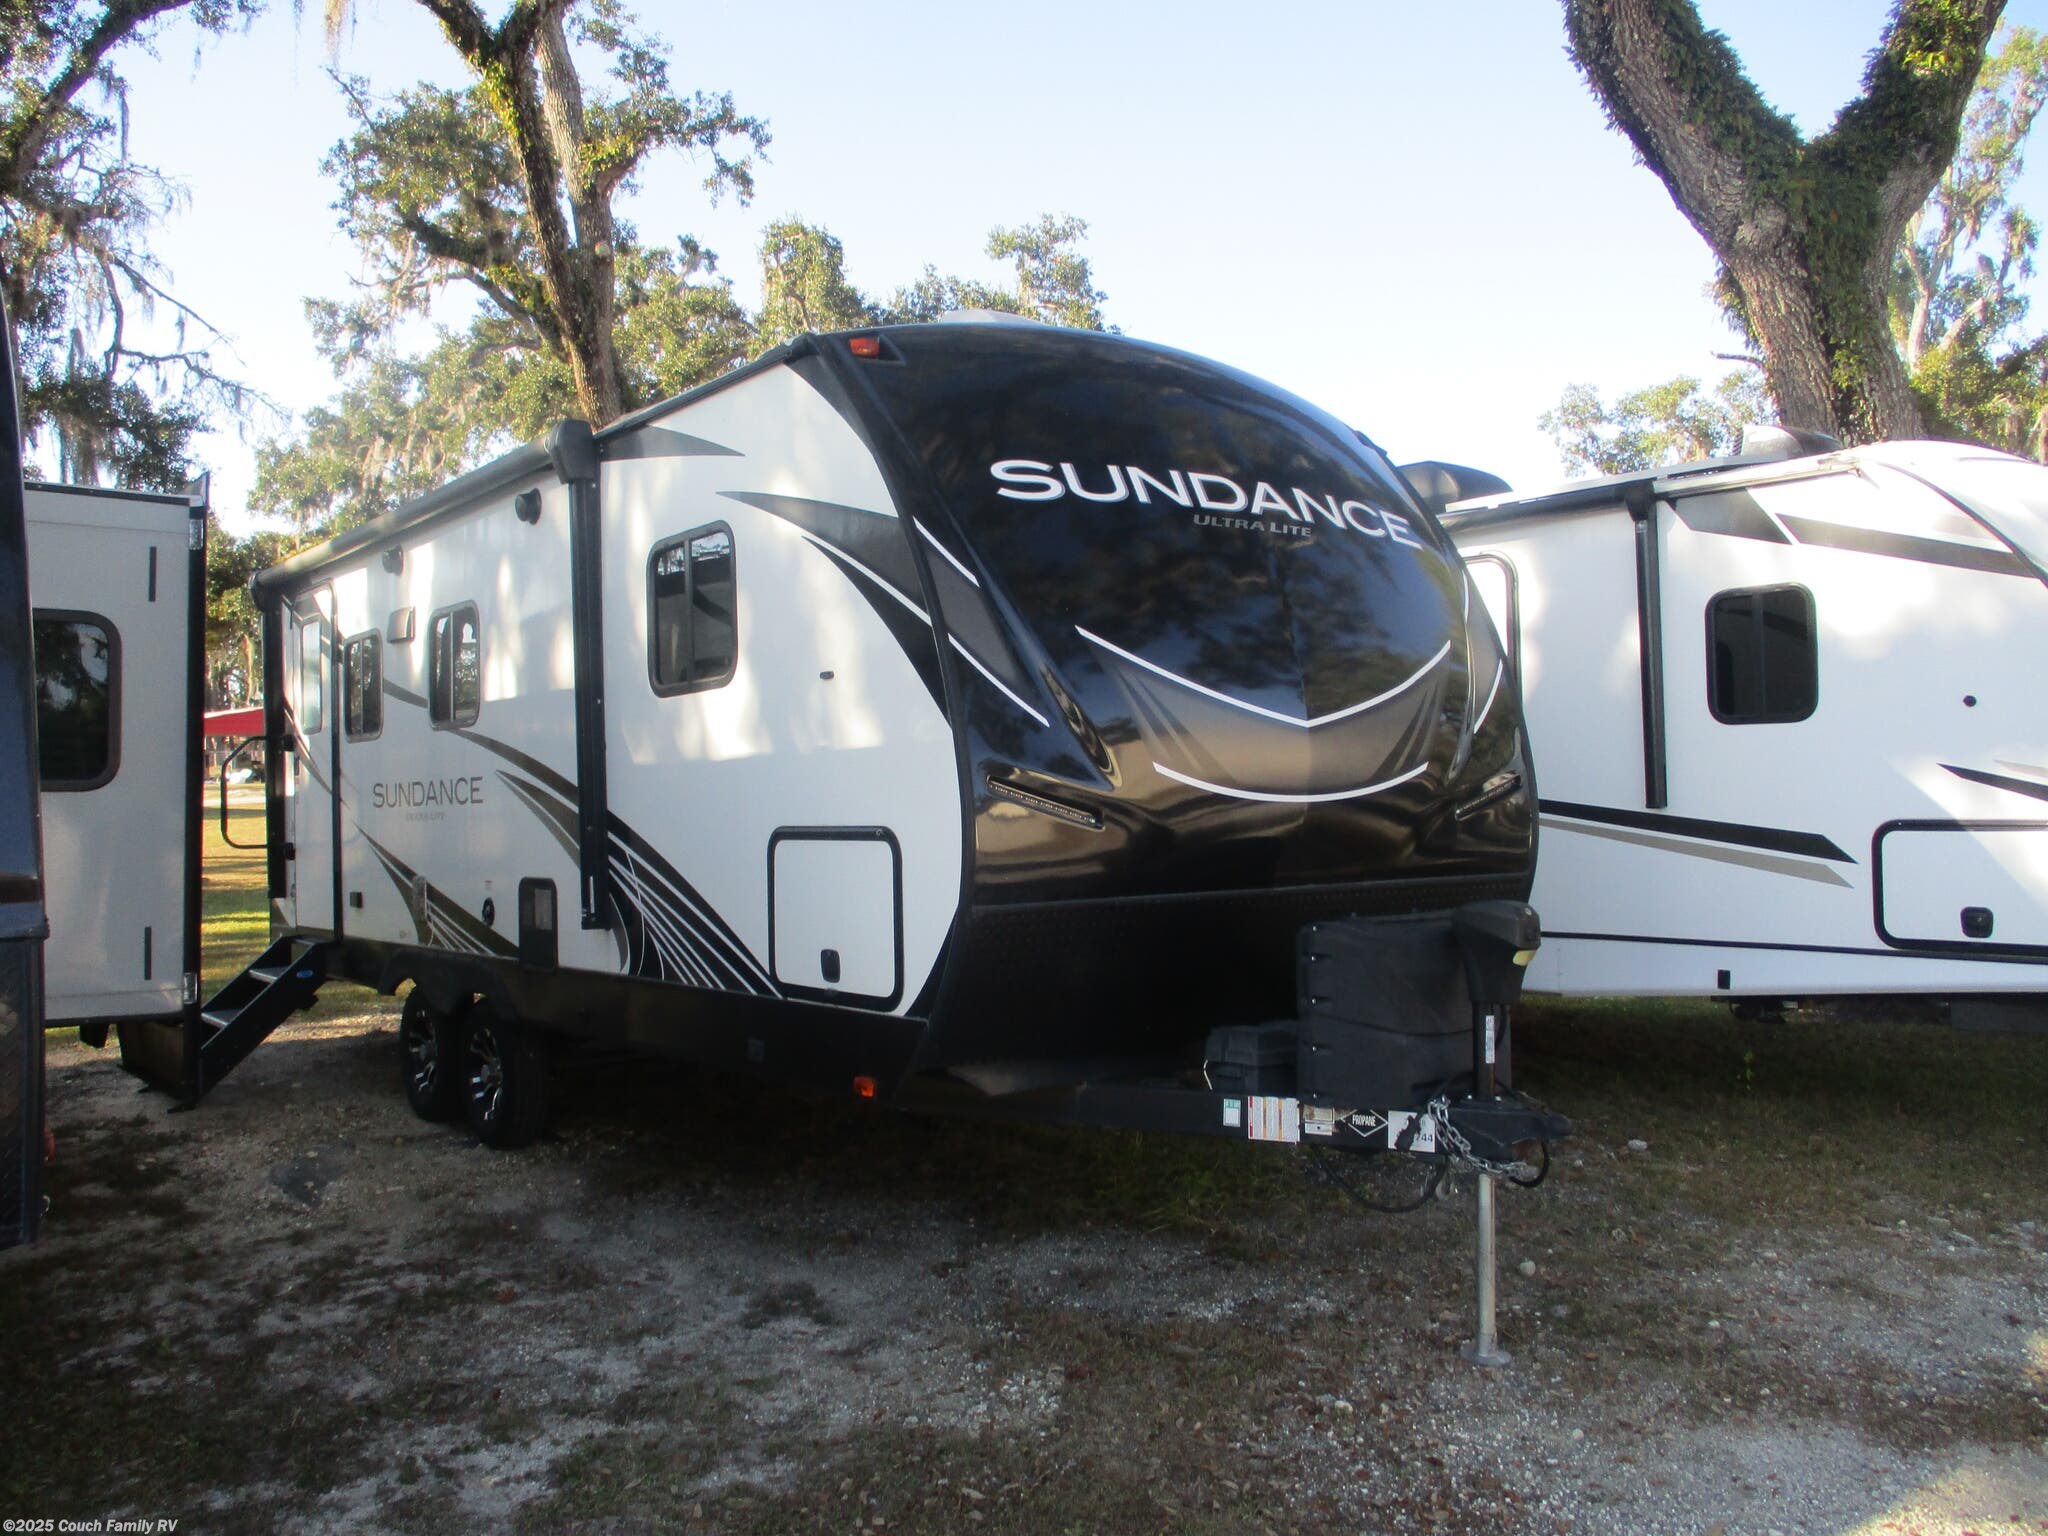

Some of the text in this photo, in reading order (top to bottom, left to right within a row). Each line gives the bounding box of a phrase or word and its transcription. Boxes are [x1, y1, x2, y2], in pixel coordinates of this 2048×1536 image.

[989, 458, 1424, 550] SUNDANCE
[1193, 513, 1313, 538] ULTRA LITE
[372, 776, 484, 809] SUNDANCE
[1352, 1113, 1377, 1127] PROPANE
